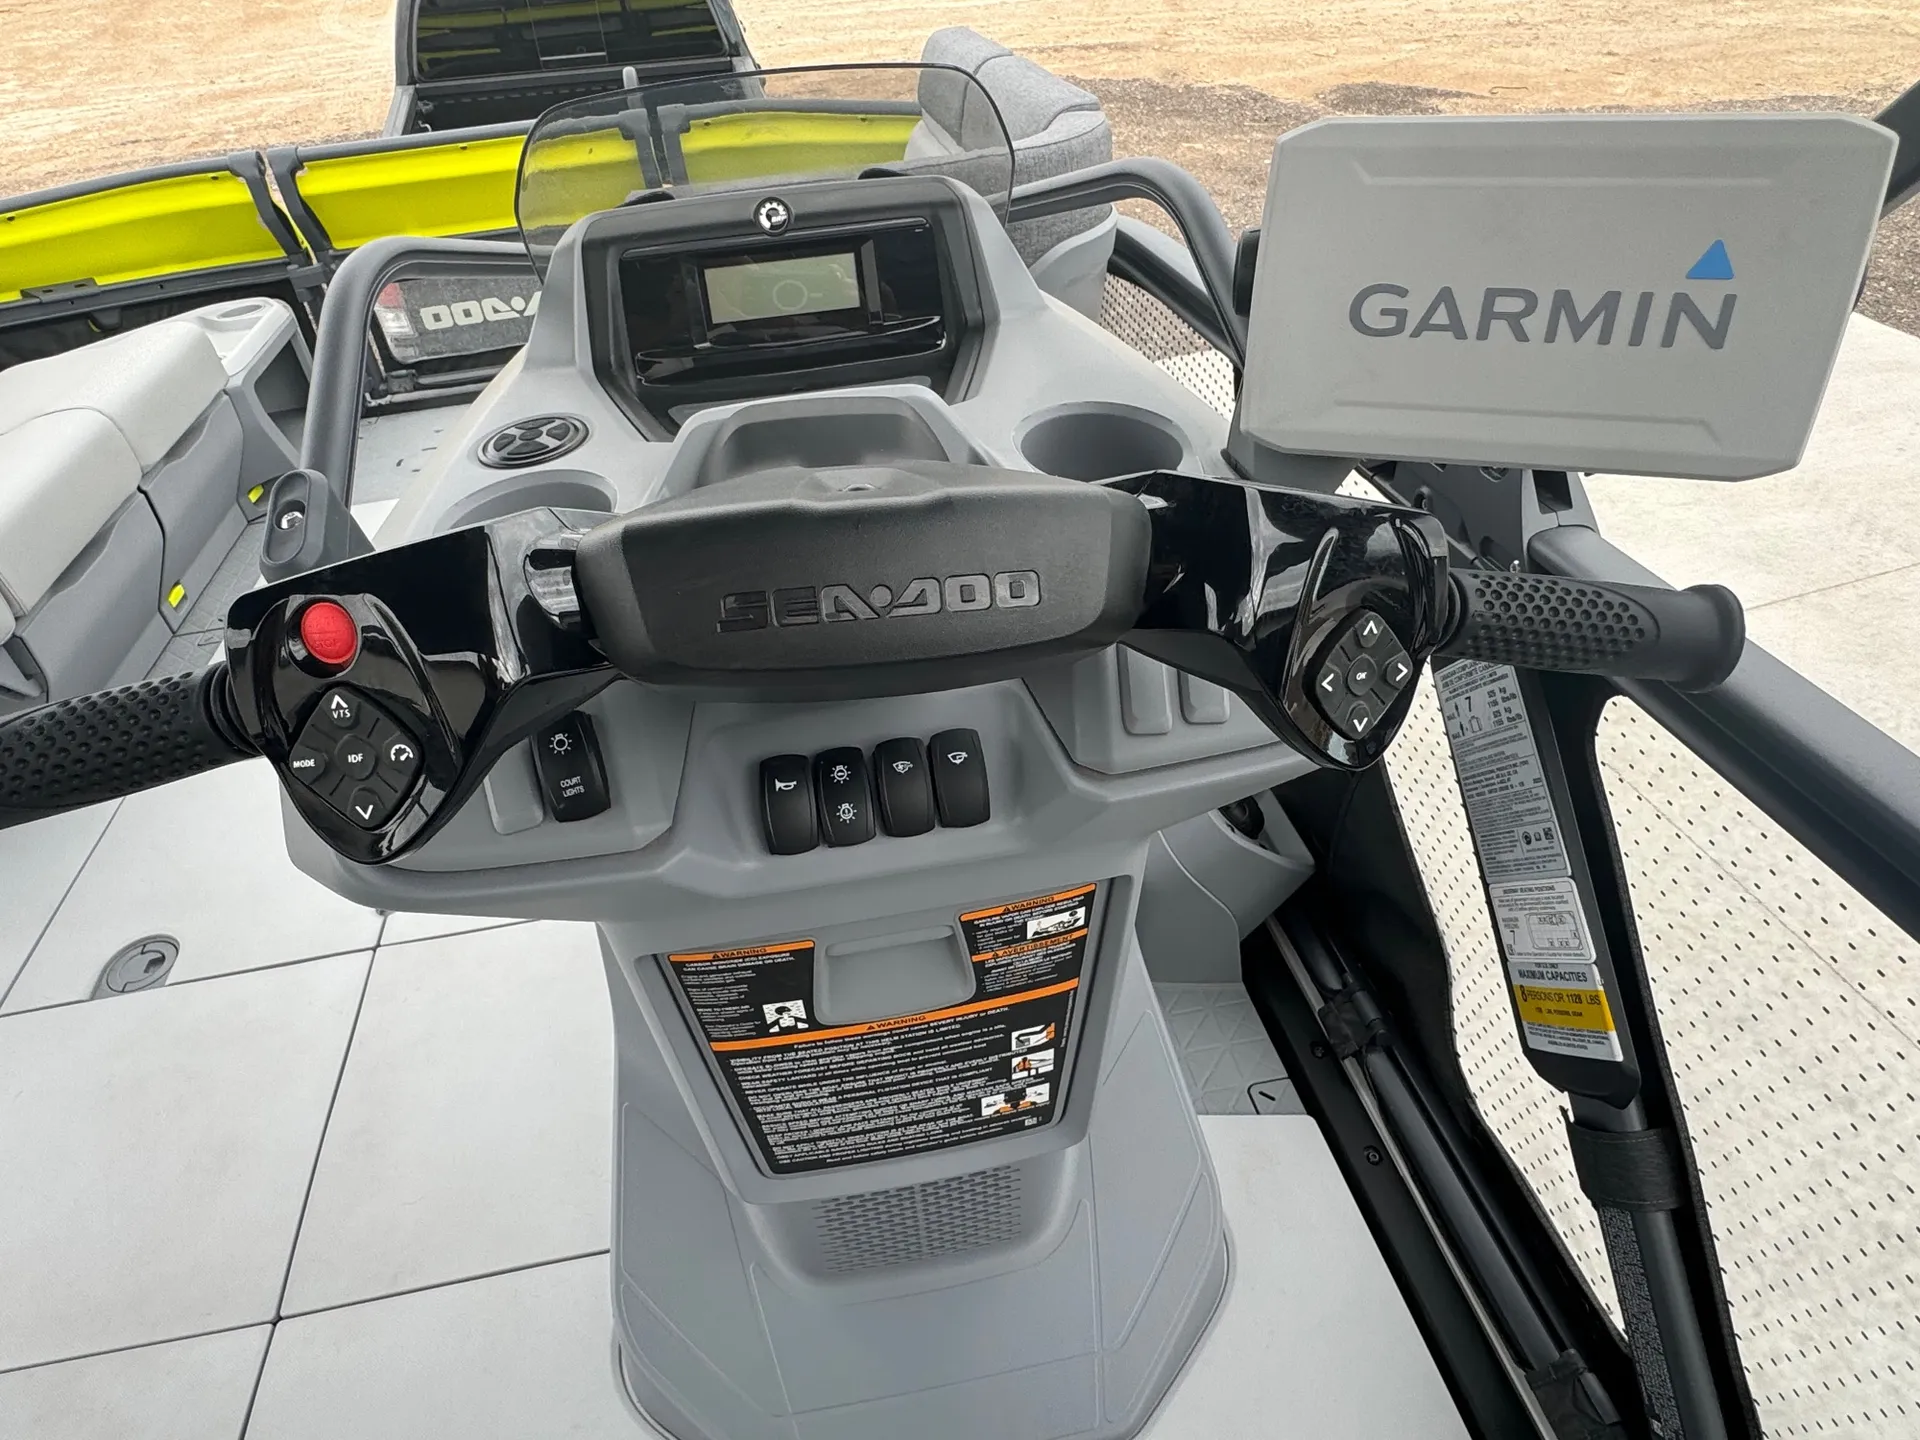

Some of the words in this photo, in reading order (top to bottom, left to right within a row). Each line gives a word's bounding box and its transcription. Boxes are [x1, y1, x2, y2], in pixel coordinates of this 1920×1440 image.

[1348, 282, 1737, 350] GARMIN
[1465, 696, 1474, 712] 7
[332, 709, 351, 719] VTS
[293, 759, 315, 769] MODE
[347, 753, 364, 763] IDF
[560, 776, 582, 788] COURT
[562, 785, 585, 798] LIGHTS
[1011, 897, 1053, 910] WARNING
[1509, 931, 1518, 944] 7
[1002, 935, 1072, 955] AVERTISSEMENT
[721, 948, 767, 957] WARNING
[1518, 969, 1545, 980] MAXIMUM
[1545, 971, 1588, 982] CAPACITIES
[1519, 985, 1529, 1002] 8
[1526, 990, 1554, 1002] PERSONS
[1553, 993, 1565, 1002] OR
[1585, 994, 1601, 1005] LBS
[877, 1016, 926, 1028] WARNING
